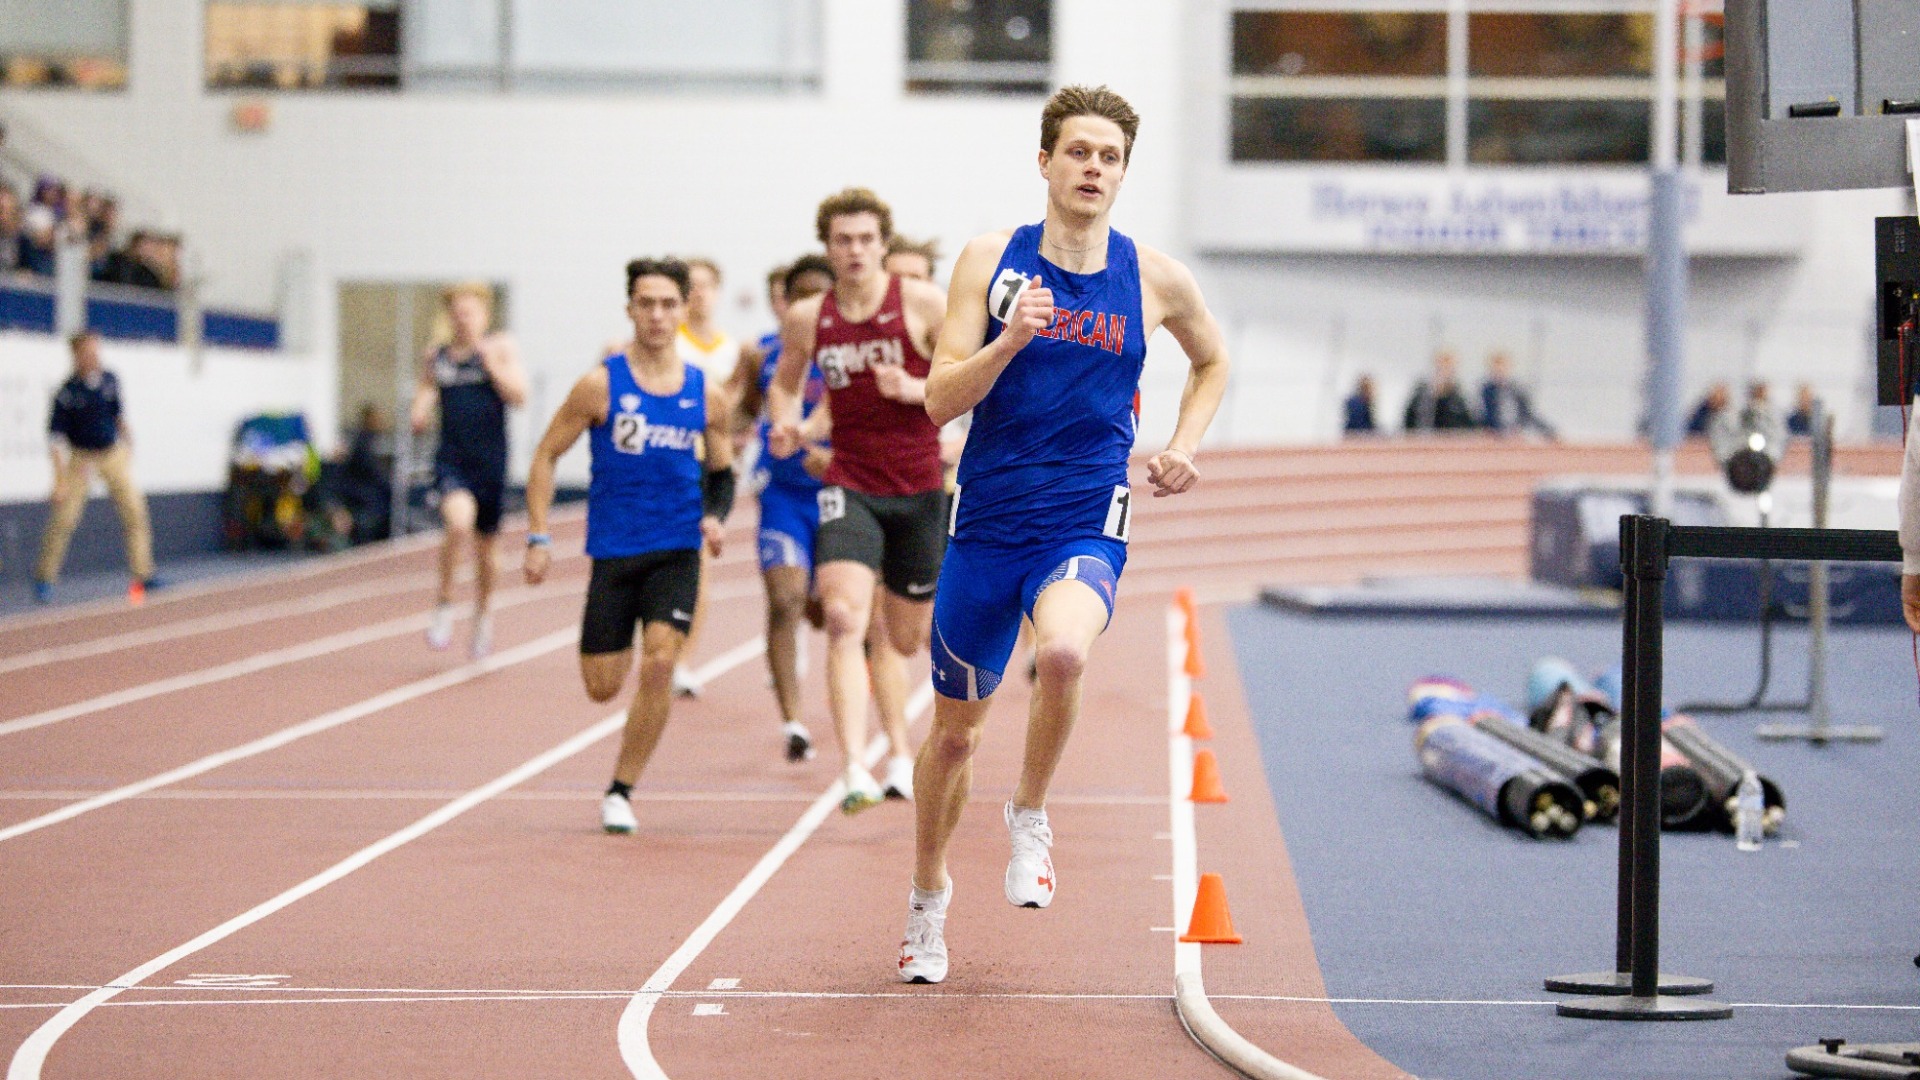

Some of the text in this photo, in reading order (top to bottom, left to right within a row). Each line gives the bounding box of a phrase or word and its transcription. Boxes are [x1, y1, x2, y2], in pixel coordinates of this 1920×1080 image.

[998, 278, 1024, 319] 1
[1000, 306, 1127, 356] RICAN
[620, 418, 639, 450] 2
[1117, 492, 1130, 537] 1
